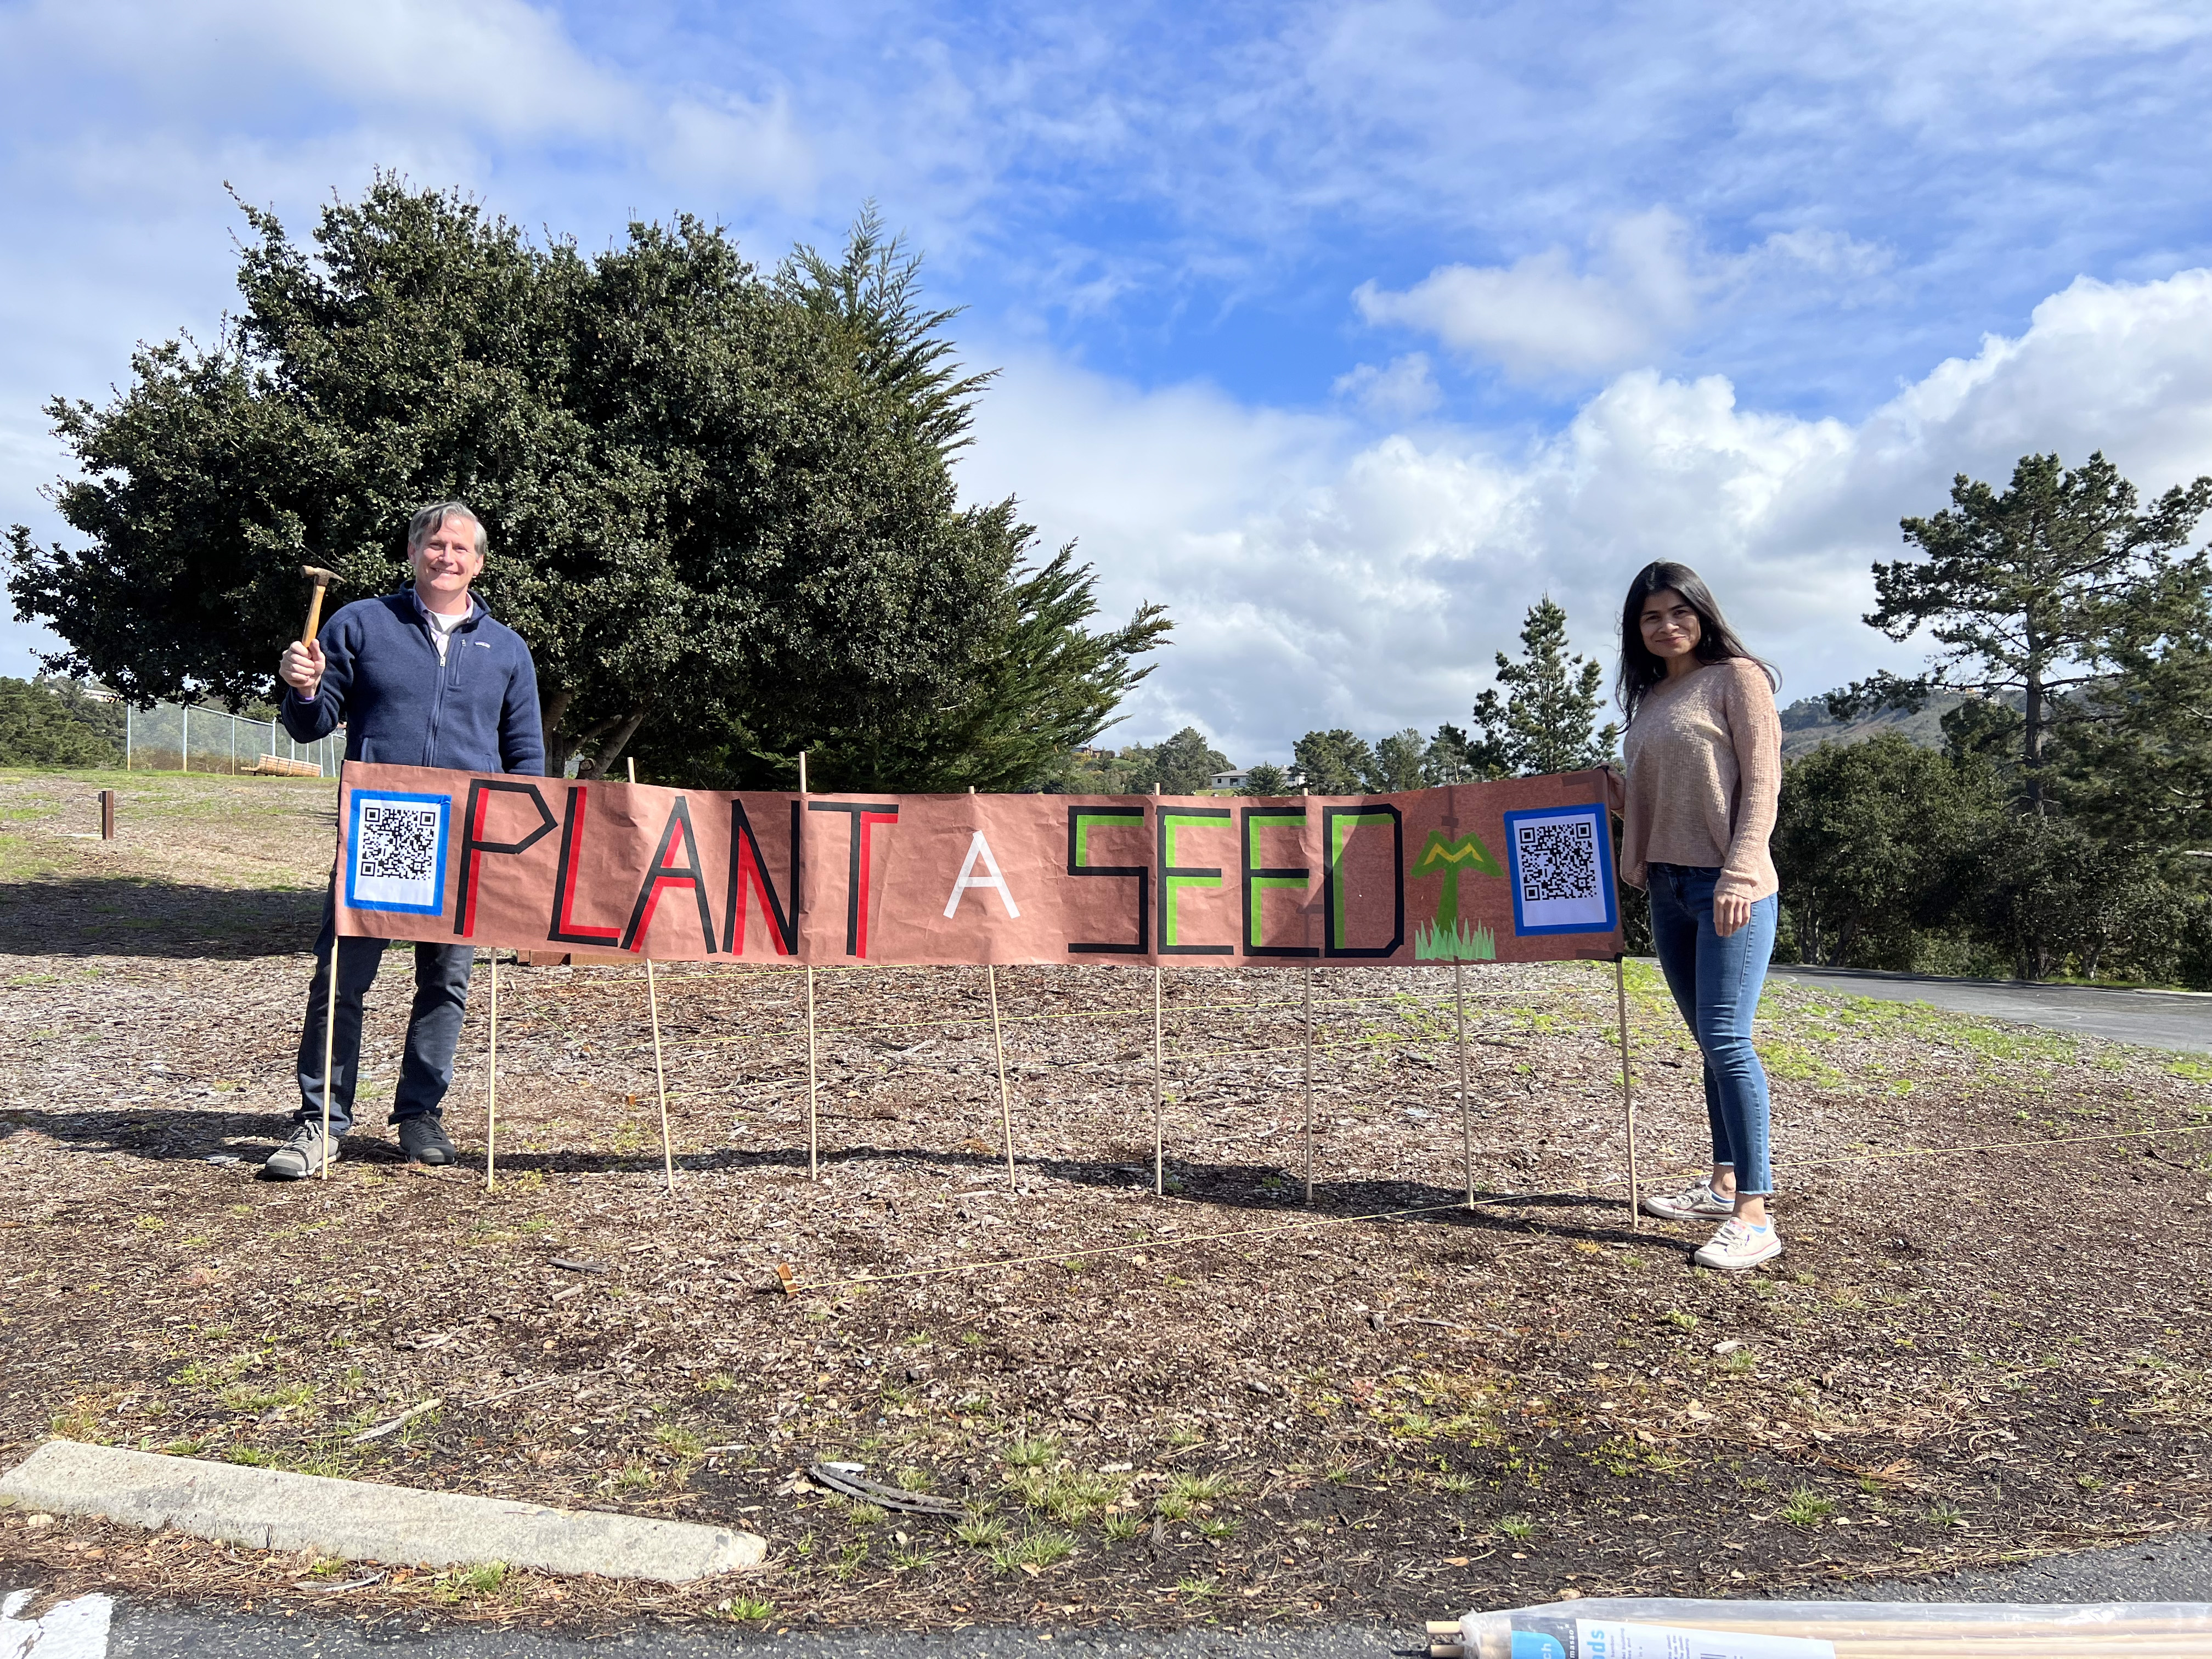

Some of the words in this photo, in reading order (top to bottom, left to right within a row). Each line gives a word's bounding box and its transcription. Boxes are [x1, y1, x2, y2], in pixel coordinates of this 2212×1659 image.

[453, 778, 899, 958] PLANT
[943, 830, 1021, 919] A
[1067, 803, 1404, 958] SEED
